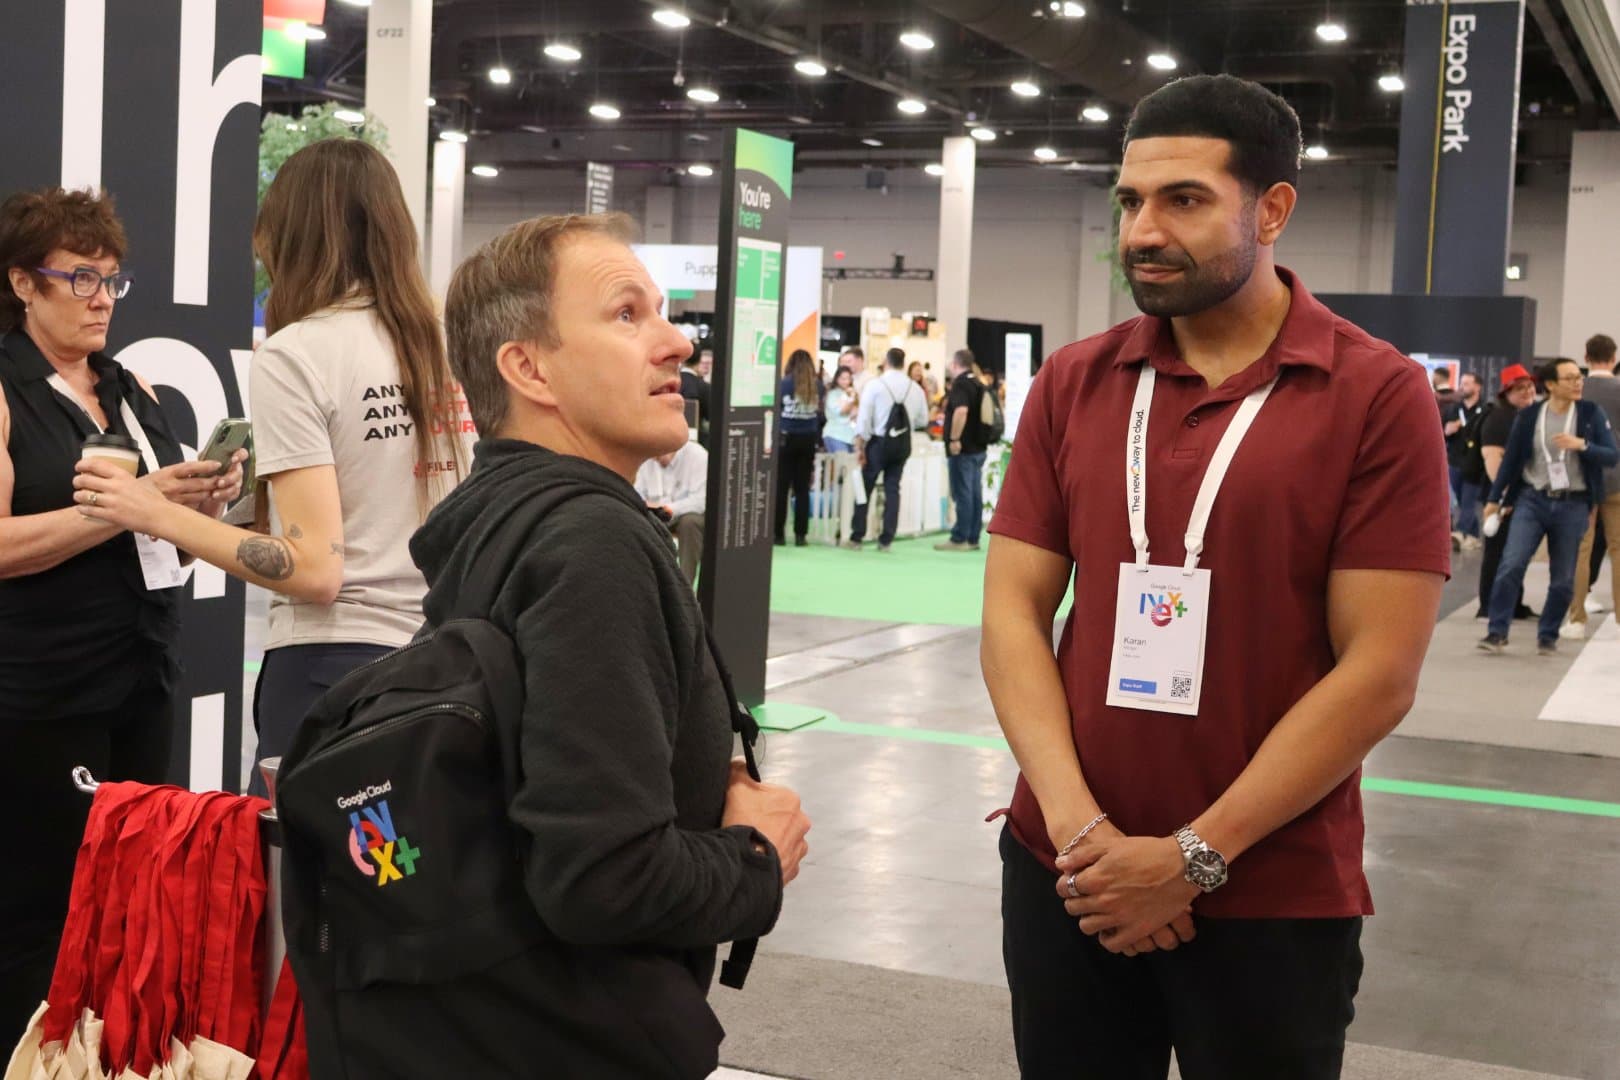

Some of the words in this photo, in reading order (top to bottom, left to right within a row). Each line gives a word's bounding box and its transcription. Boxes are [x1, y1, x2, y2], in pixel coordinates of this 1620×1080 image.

[1442, 14, 1476, 84] Expo
[1442, 90, 1472, 153] Park
[740, 181, 771, 209] You're
[738, 206, 762, 230] here
[362, 384, 406, 401] ANY
[363, 403, 410, 421] ANY
[1133, 409, 1145, 434] cloud.
[363, 422, 414, 441] ANY
[1133, 434, 1141, 445] to
[1133, 447, 1143, 465] way
[1132, 495, 1140, 514] The
[337, 790, 368, 809] Google
[366, 779, 392, 798] Cloud
